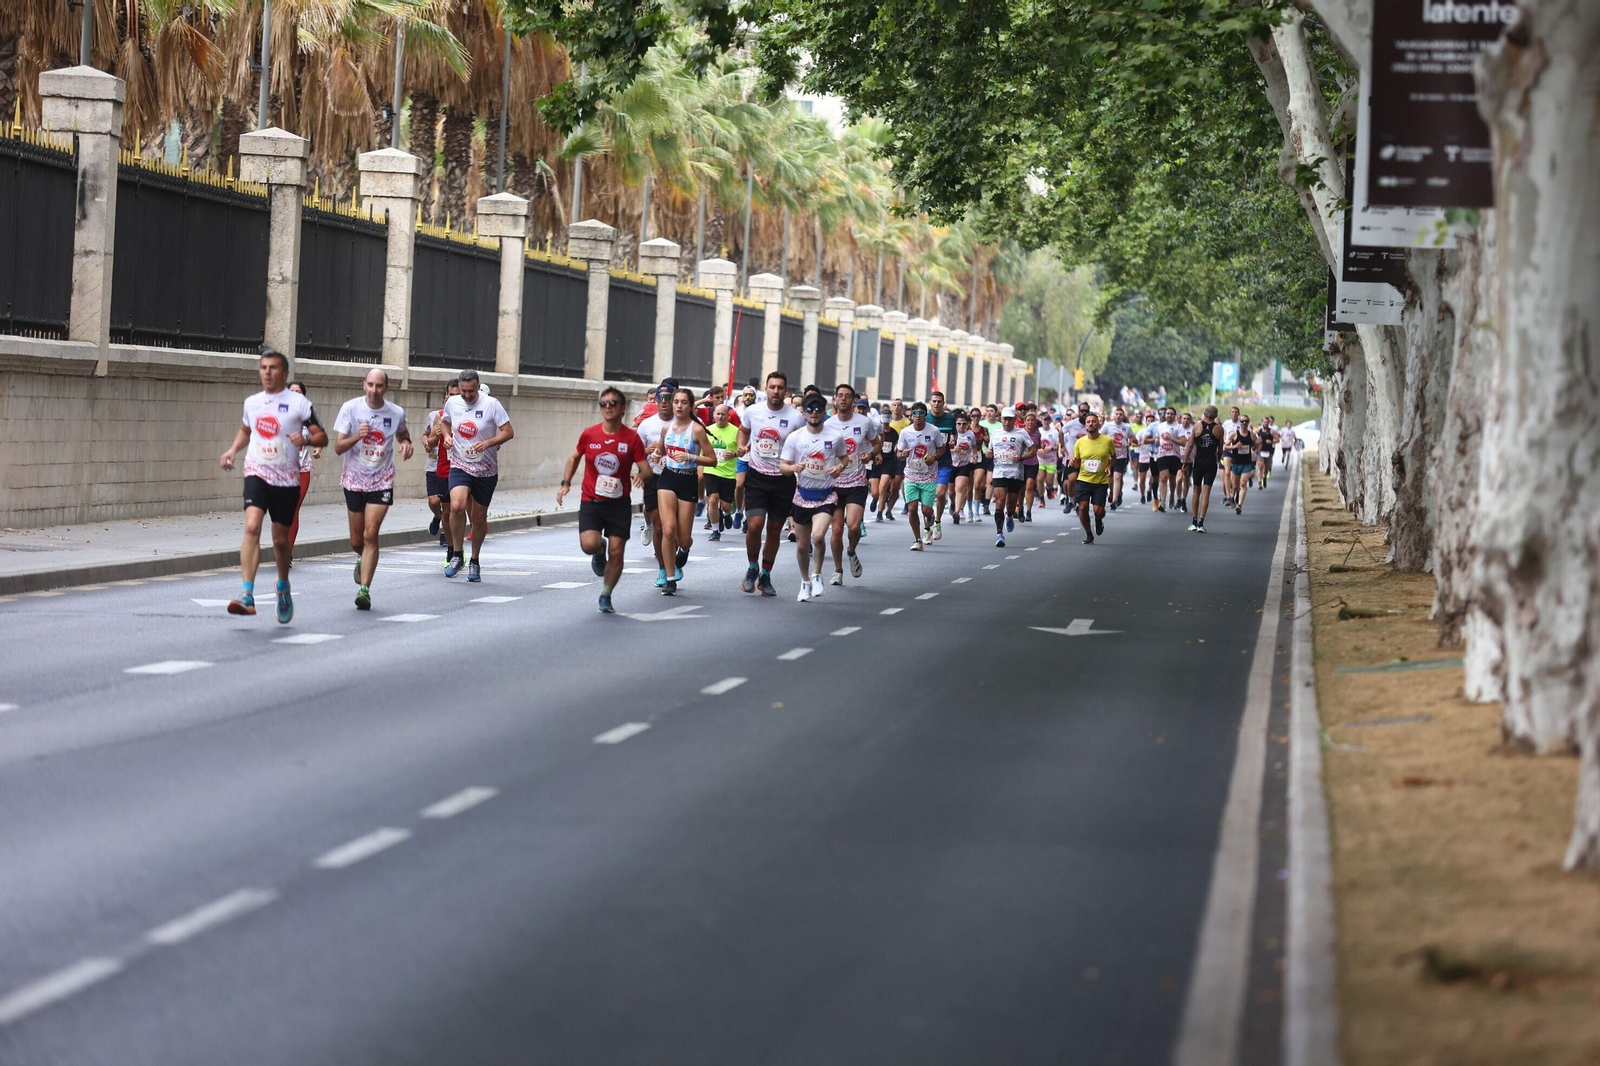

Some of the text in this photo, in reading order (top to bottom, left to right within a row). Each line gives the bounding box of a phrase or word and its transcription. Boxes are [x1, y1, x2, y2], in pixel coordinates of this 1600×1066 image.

[1422, 0, 1519, 23] latente
[1222, 364, 1234, 381] P
[257, 424, 277, 435] FRENO
[258, 419, 278, 430] PONLE
[364, 449, 385, 457] 1340
[597, 462, 616, 471] FRENO
[598, 457, 617, 467] PONLE
[806, 462, 824, 471] 1335
[602, 481, 619, 489] 353
